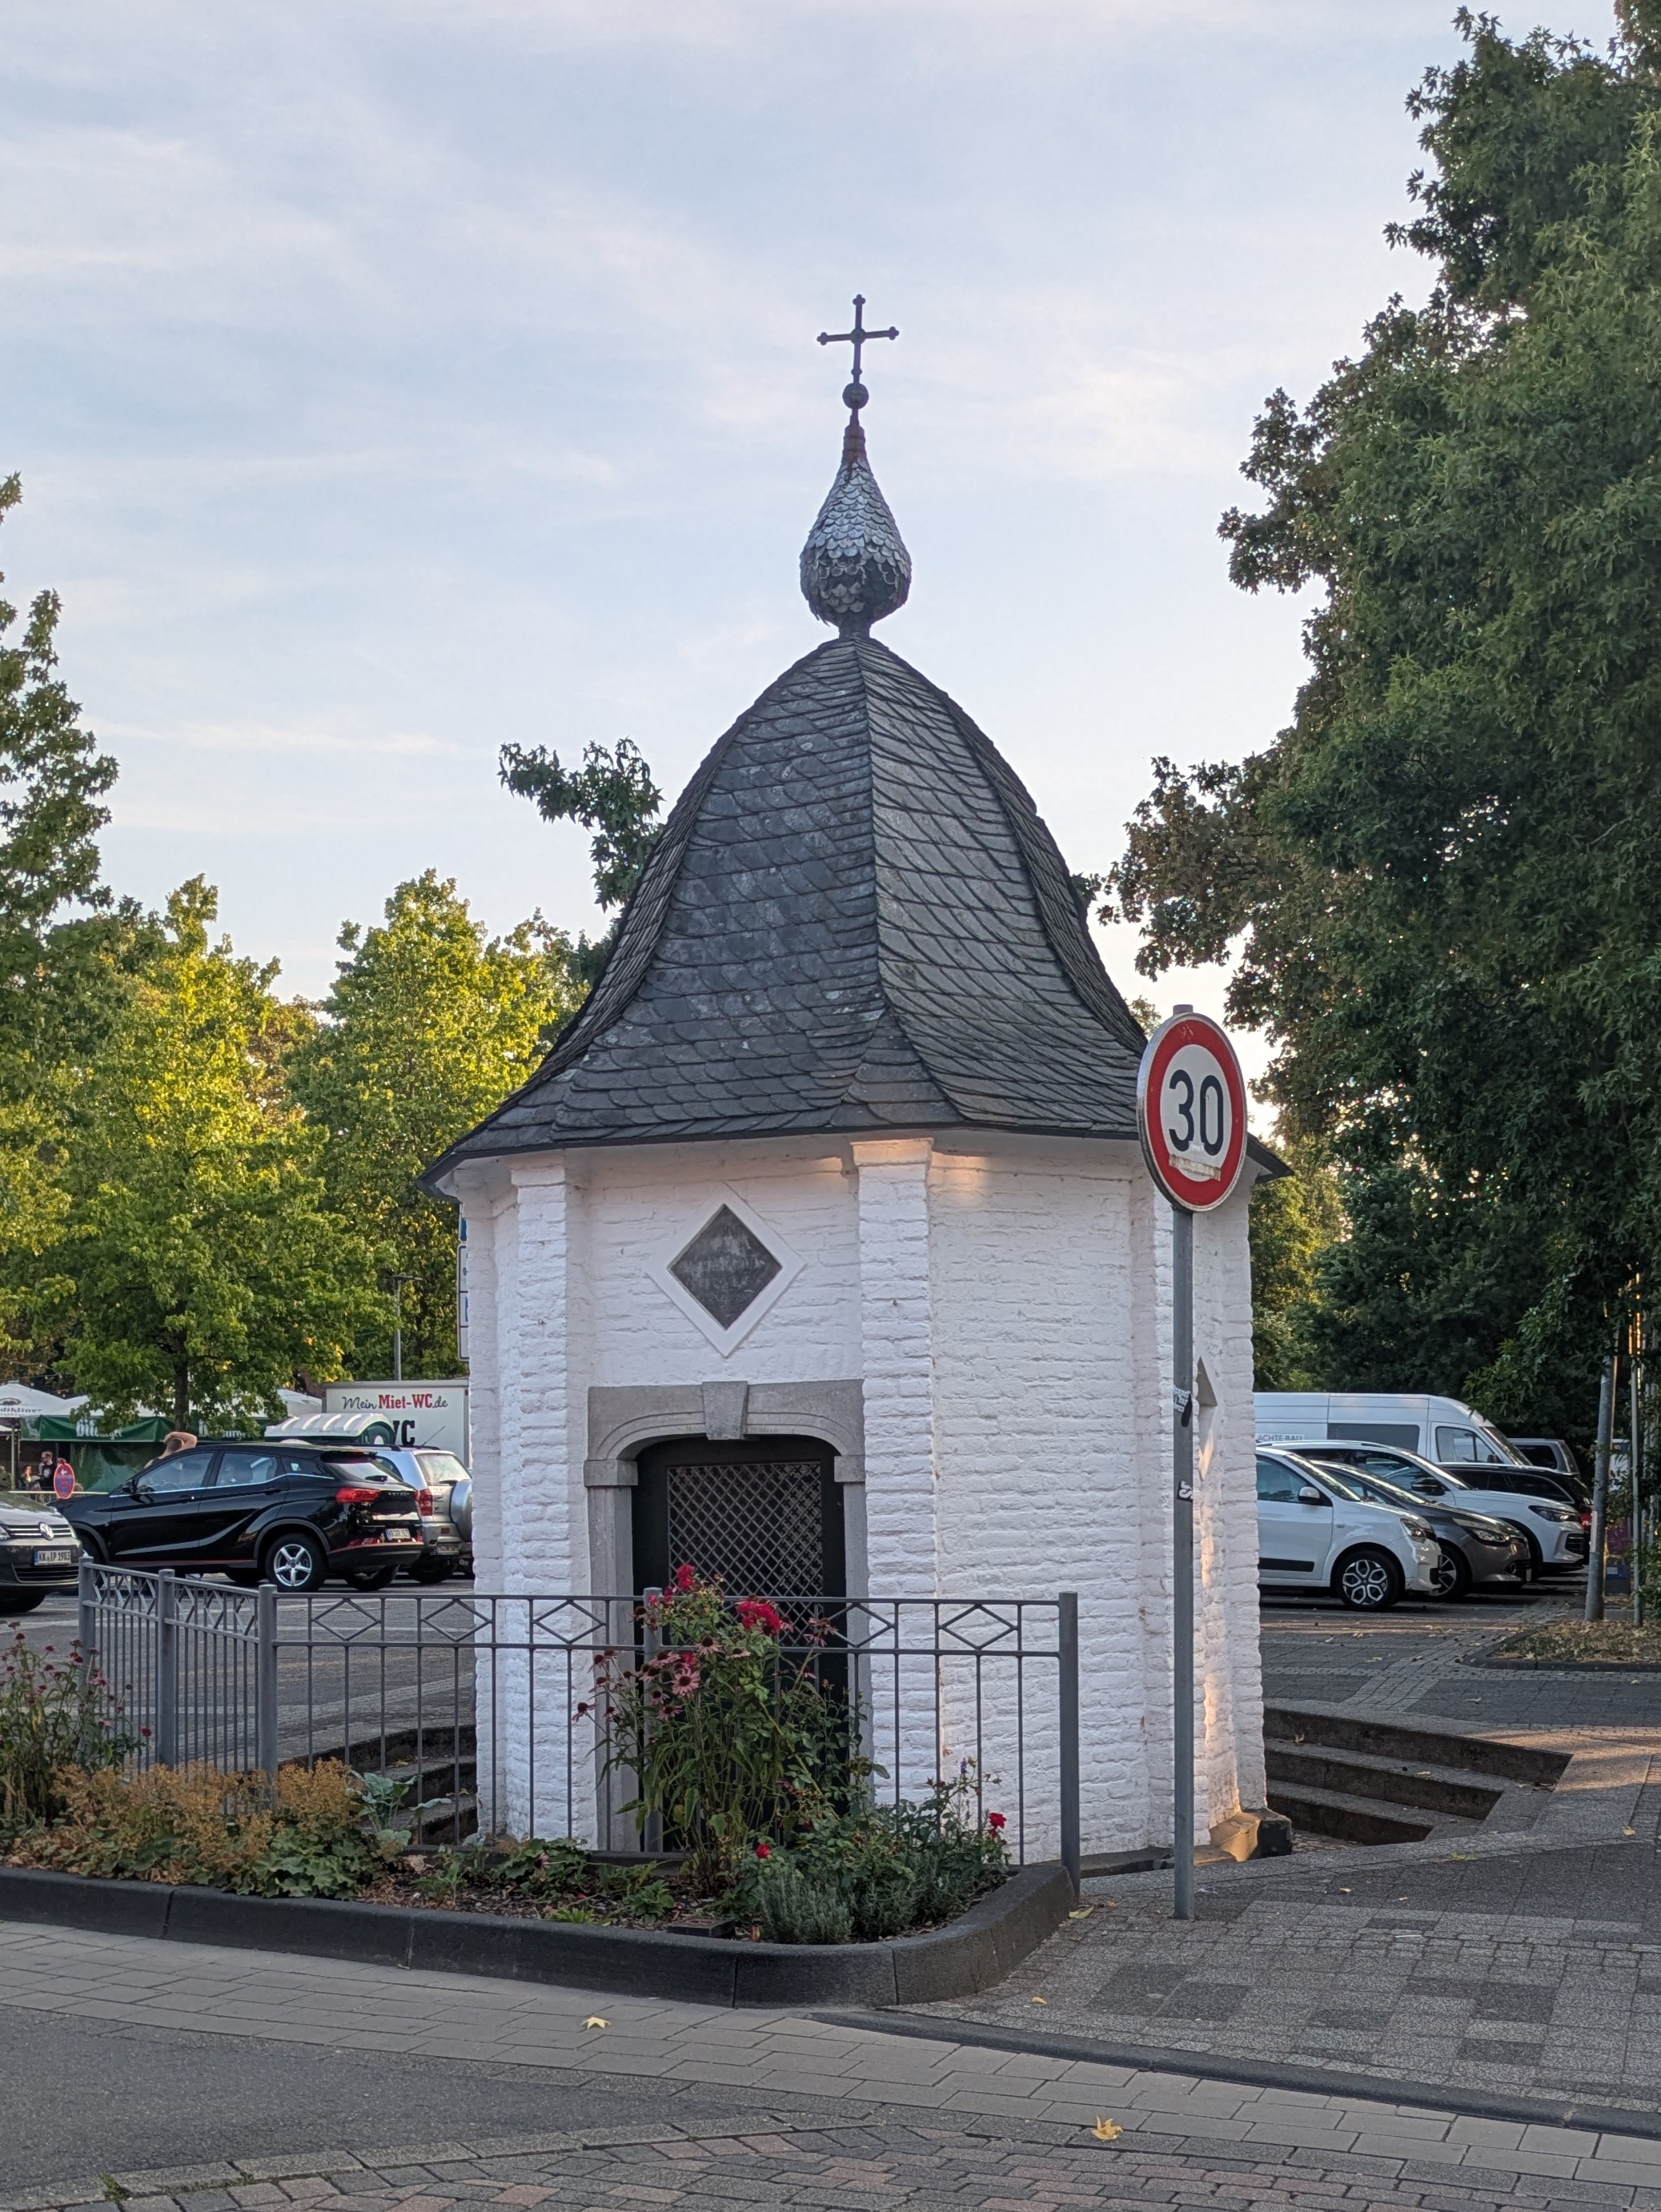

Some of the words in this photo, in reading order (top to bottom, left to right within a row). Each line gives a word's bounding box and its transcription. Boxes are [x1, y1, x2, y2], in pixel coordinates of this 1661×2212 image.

[1169, 1069, 1224, 1156] 30
[342, 1397, 377, 1409] Mein
[379, 1393, 448, 1409] Miet-WC.de
